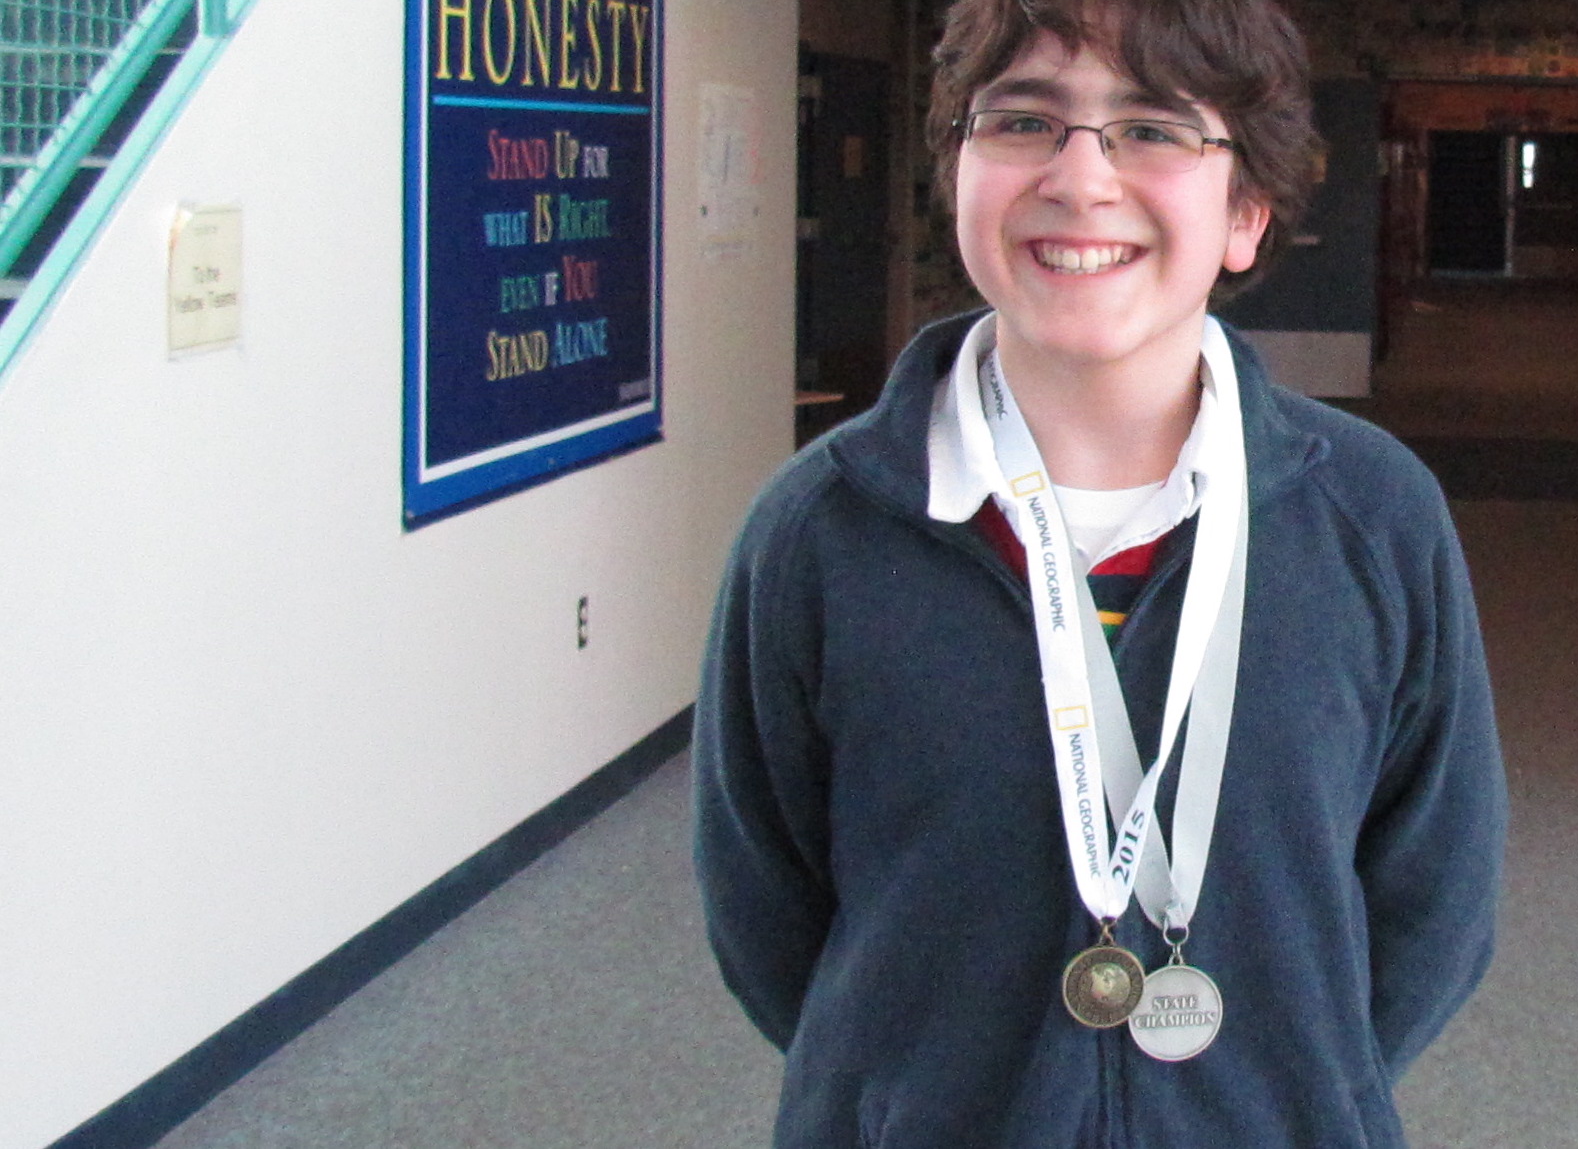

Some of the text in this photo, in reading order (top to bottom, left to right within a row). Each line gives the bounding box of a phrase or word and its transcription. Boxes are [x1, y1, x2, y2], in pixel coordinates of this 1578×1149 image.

[488, 129, 609, 180] STAND UP FOR
[483, 211, 529, 247] WHAT
[534, 194, 553, 244] IS
[563, 255, 597, 301] YOU
[487, 317, 608, 381] STAND ALONE
[1027, 496, 1065, 632] NATIONAL GEOGRAPHIC
[1069, 733, 1101, 880] NATIONAL GEOGRAPHIC
[1112, 809, 1145, 885] 2015
[1134, 1011, 1217, 1028] CHAMPION
[1151, 995, 1199, 1010] STATE
